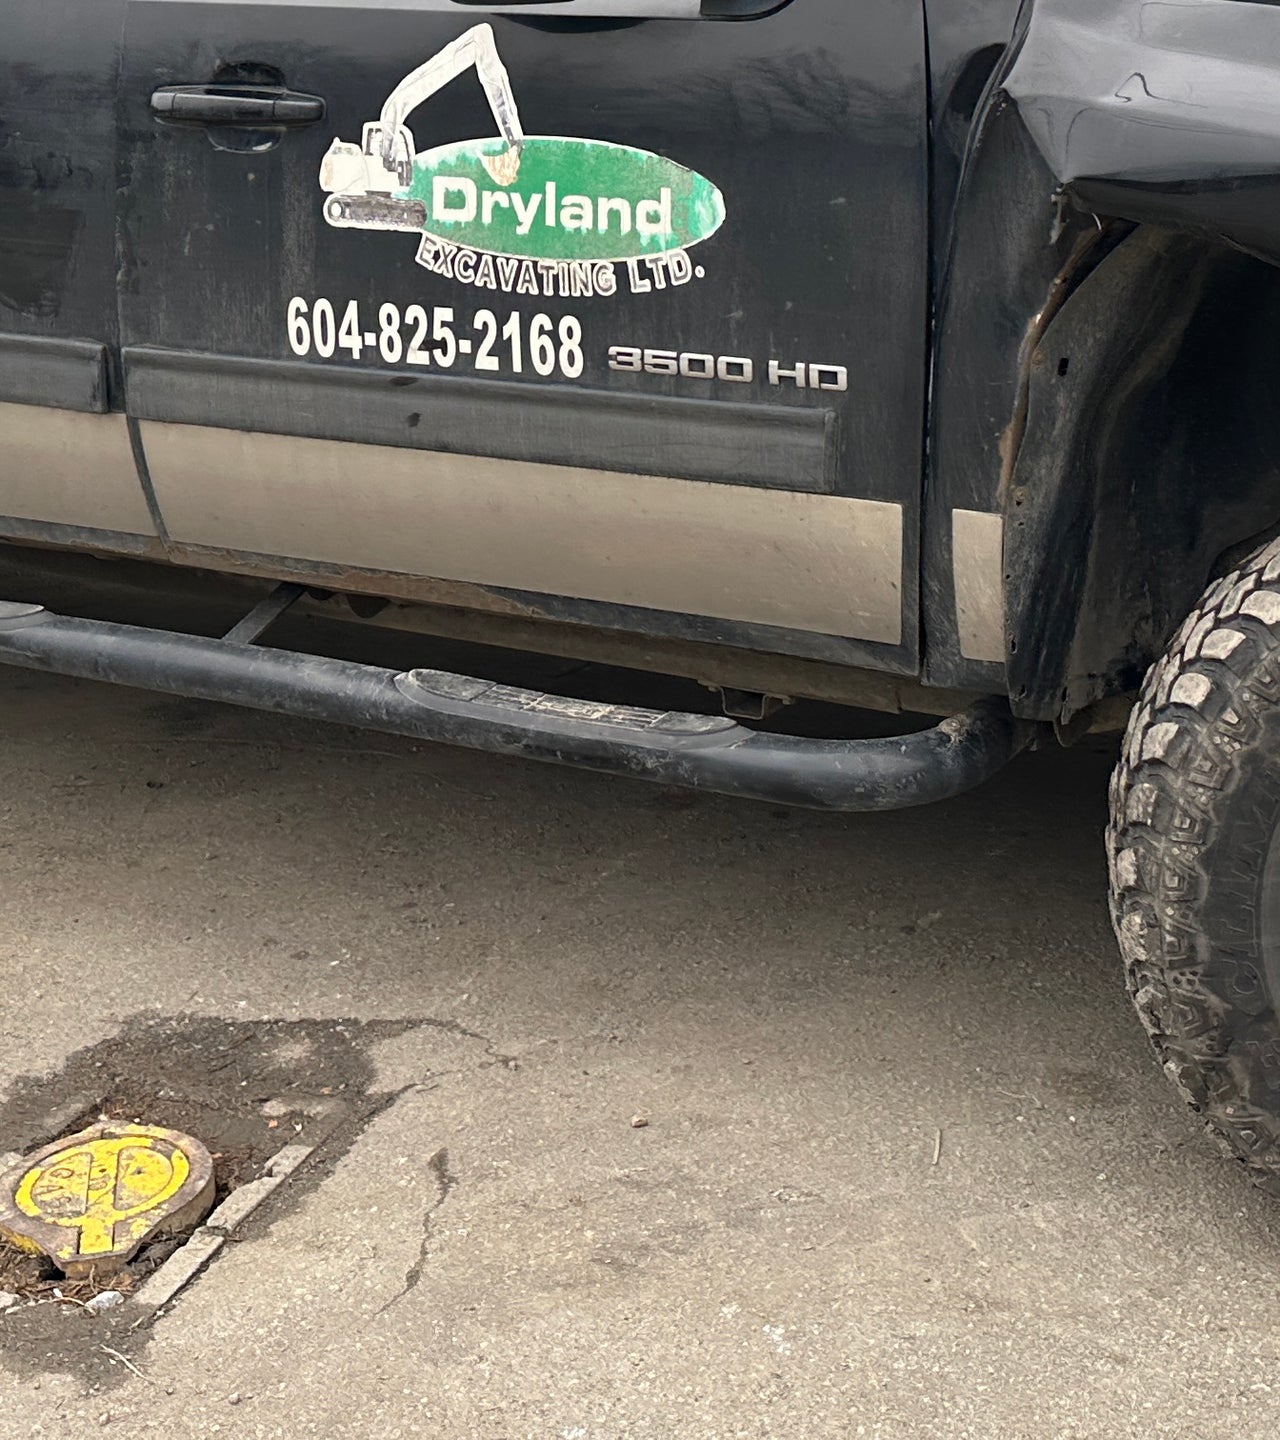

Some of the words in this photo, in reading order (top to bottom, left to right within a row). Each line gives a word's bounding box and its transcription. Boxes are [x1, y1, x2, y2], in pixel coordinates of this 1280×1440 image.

[432, 175, 672, 236] Dryland
[415, 233, 617, 298] EXCAVATING
[626, 248, 706, 294] LTD.
[286, 296, 584, 378] 604-825-2168
[607, 345, 754, 383] 3500
[768, 359, 849, 392] HD
